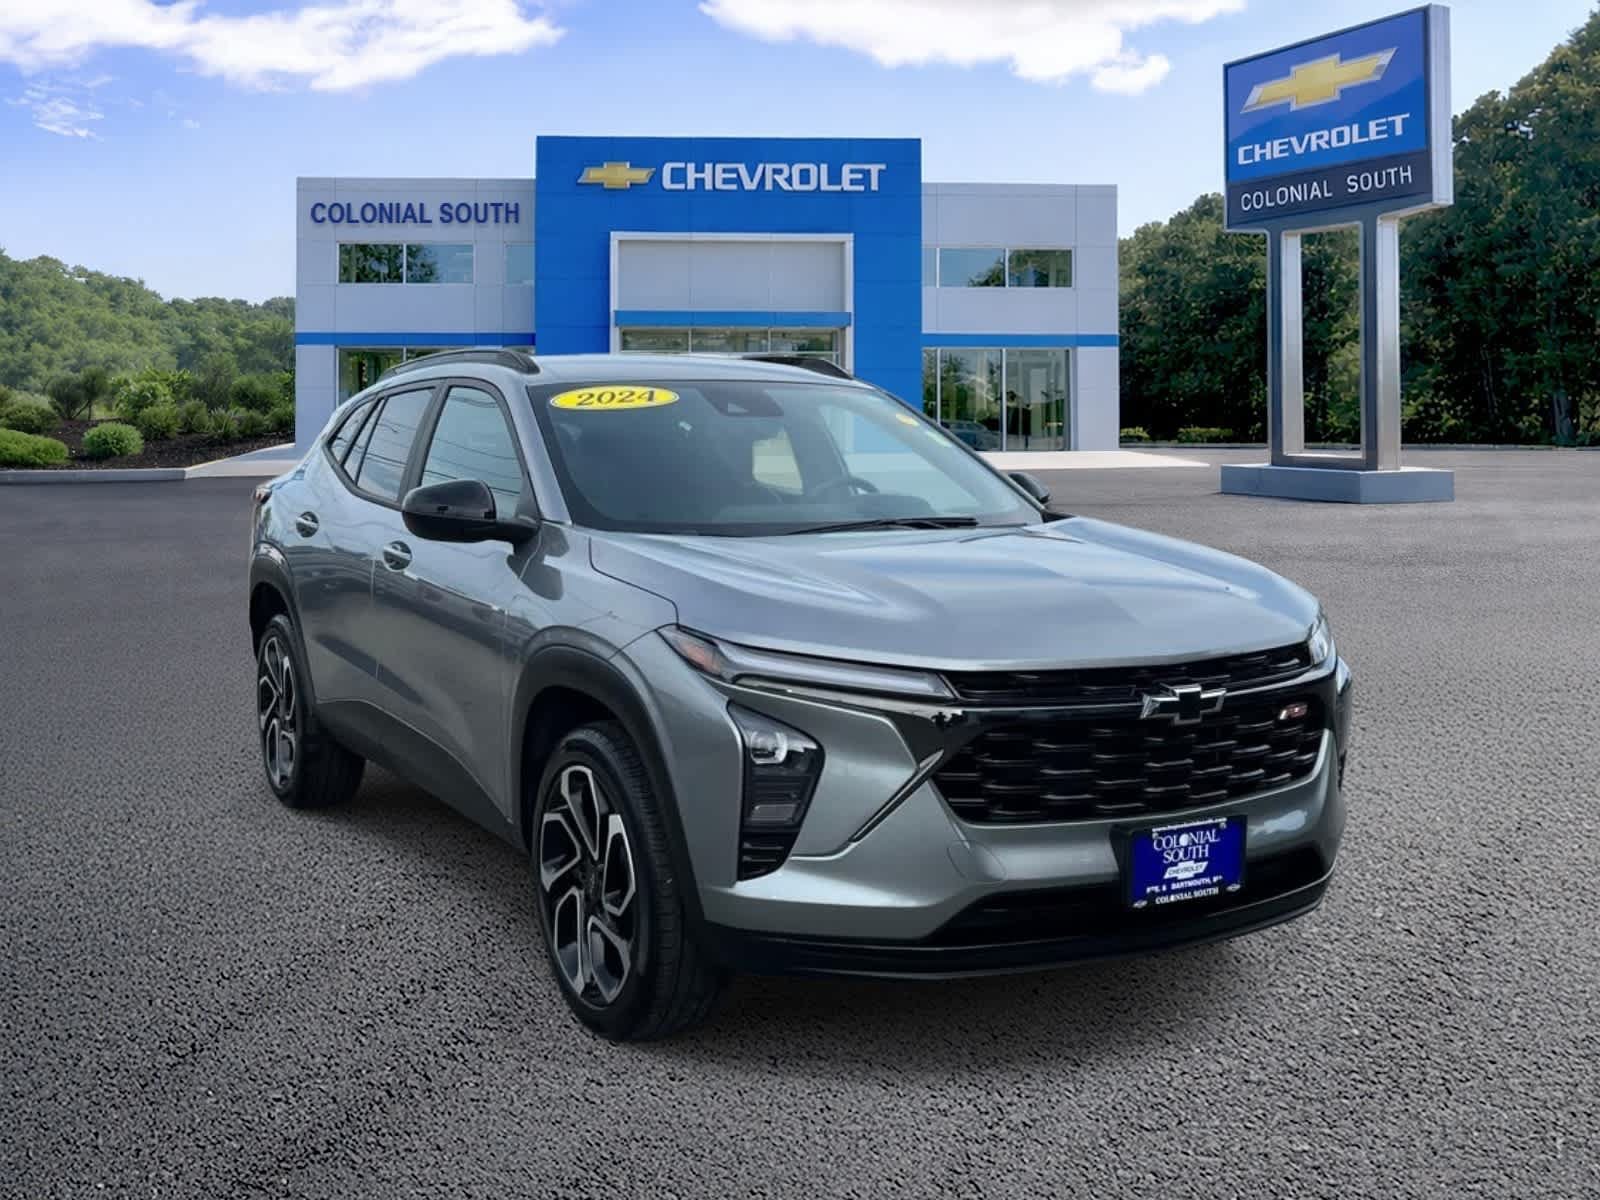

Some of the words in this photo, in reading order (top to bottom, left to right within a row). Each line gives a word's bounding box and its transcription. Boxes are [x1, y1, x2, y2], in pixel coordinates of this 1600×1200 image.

[1237, 113, 1410, 165] CHEVROLET
[661, 161, 888, 193] CHEVROLET
[1240, 179, 1333, 212] COLONIAL
[1346, 164, 1413, 194] SOUTH
[310, 201, 433, 225] COLONIAL
[439, 201, 520, 225] SOUTH
[576, 389, 656, 407] 2024
[1153, 829, 1220, 851] COLONIAL
[1163, 844, 1209, 864] SOUTH
[1155, 891, 1193, 904] COLONIAL
[1193, 886, 1219, 899] SOUTH
